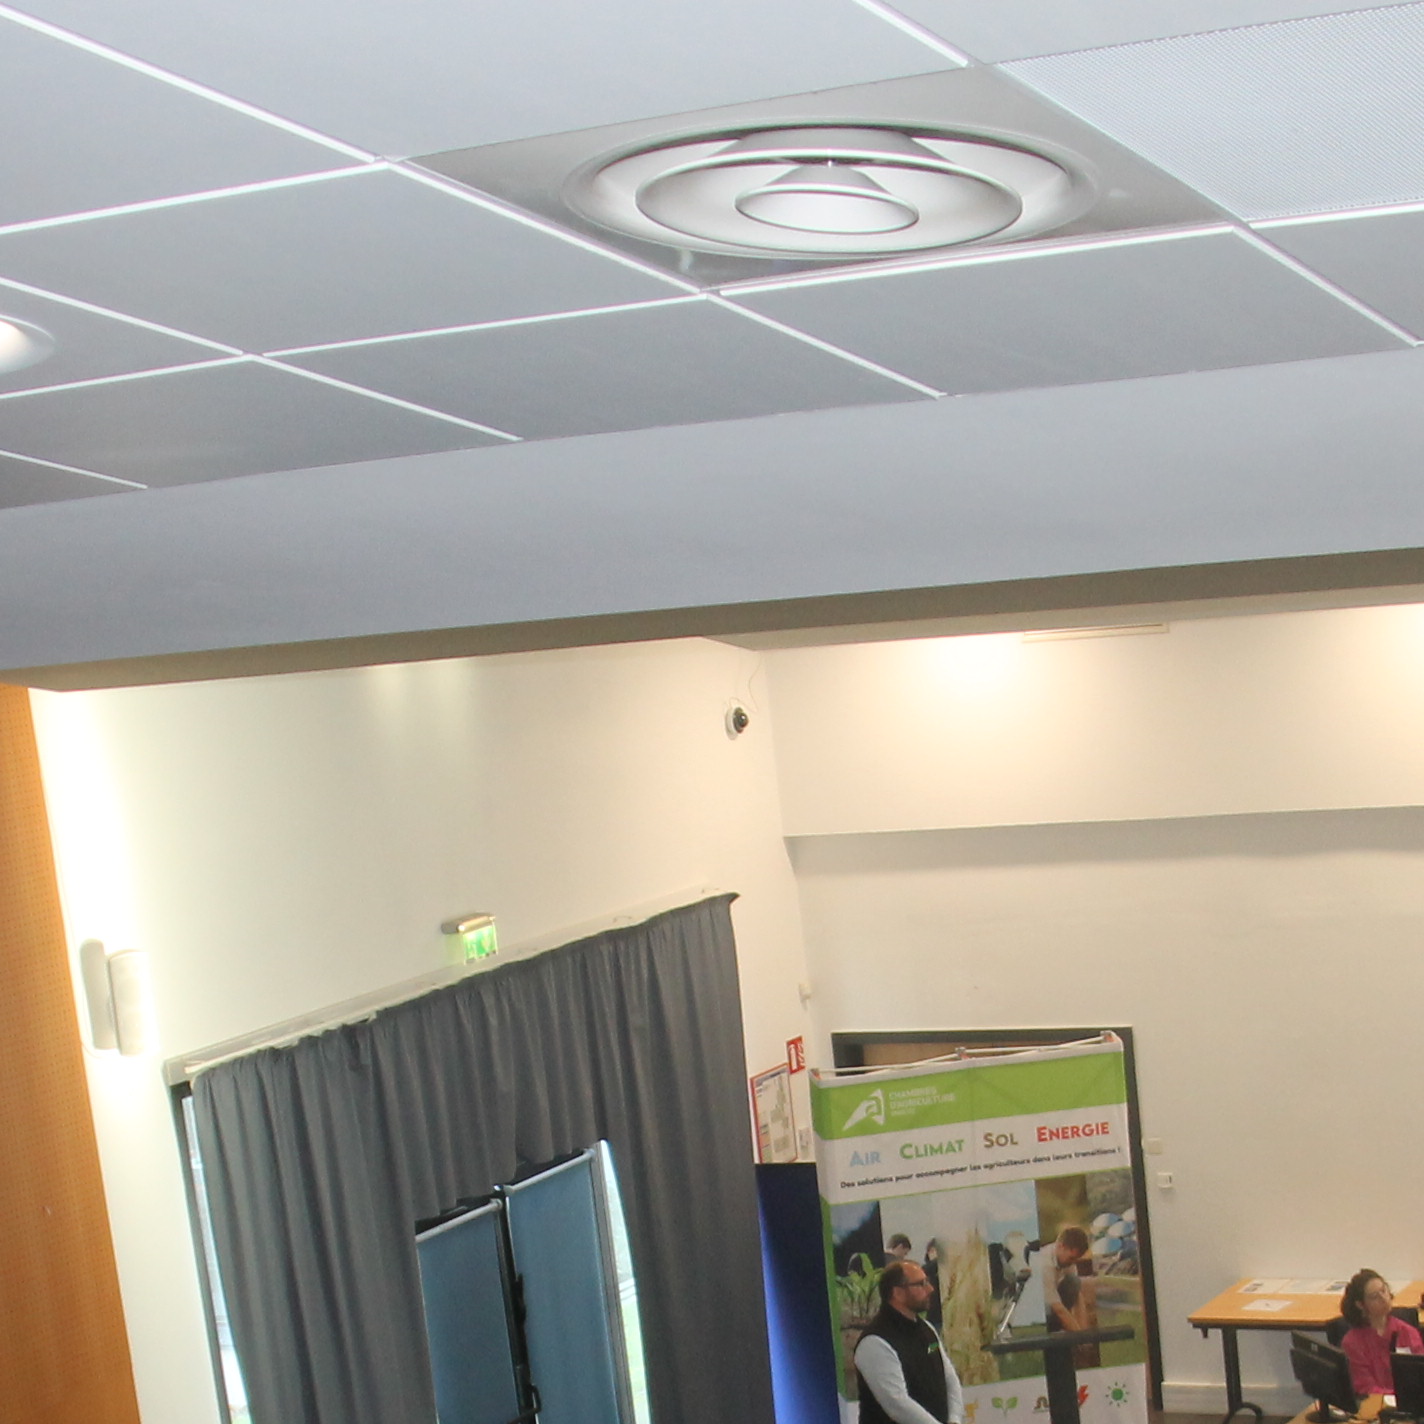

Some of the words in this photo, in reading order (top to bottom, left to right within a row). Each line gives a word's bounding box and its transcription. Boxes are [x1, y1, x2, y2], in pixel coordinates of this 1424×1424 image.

[899, 1139, 964, 1160] CLIMAT
[983, 1132, 1018, 1148] SOL
[1036, 1121, 1110, 1143] ENERGIE
[840, 1180, 856, 1189] Des
[857, 1175, 894, 1187] solutions
[894, 1172, 914, 1183] pour
[915, 1164, 968, 1179] accompagner
[969, 1163, 981, 1171] les
[982, 1157, 1031, 1171] agriculteurs
[1032, 1154, 1051, 1163] dans
[1052, 1152, 1073, 1162] leurs
[1074, 1147, 1116, 1158] transitions
